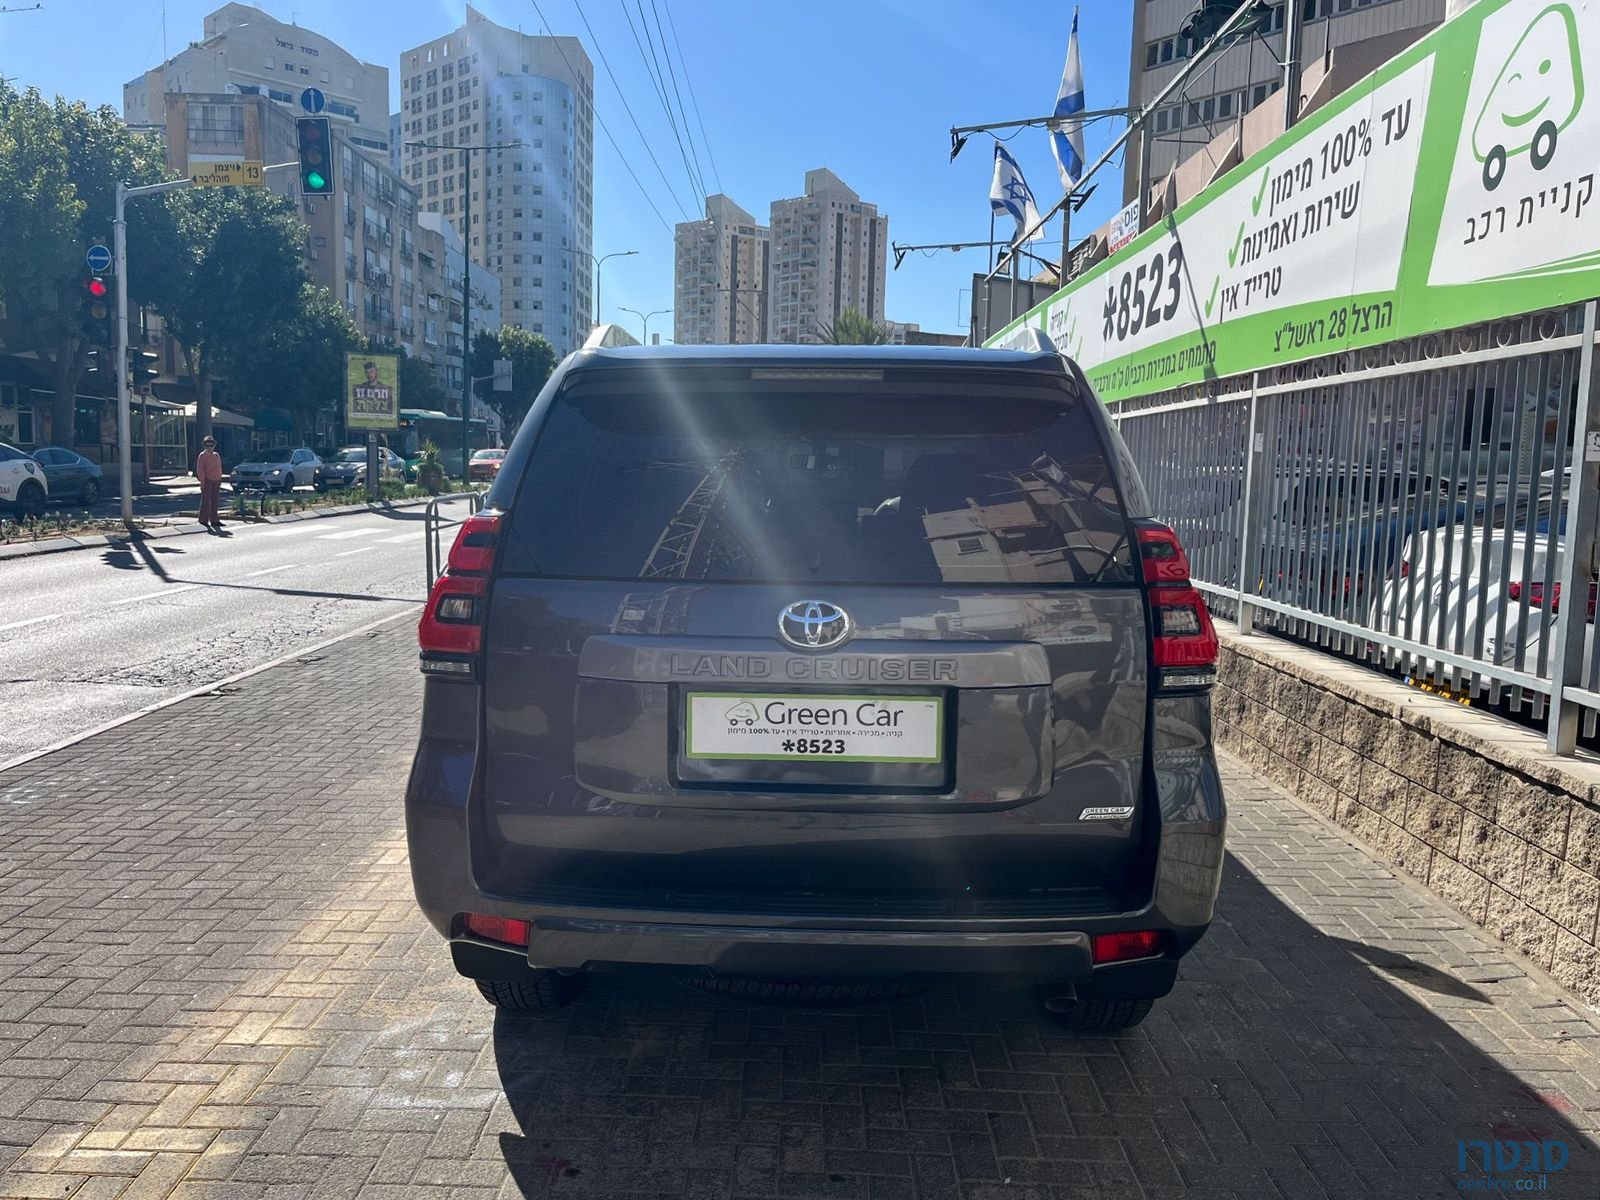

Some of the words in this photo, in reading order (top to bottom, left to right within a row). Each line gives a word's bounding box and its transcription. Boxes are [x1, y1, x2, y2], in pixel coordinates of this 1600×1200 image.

[1381, 98, 1412, 146] עד
[1320, 117, 1372, 180] 100%
[198, 172, 230, 183] מוהליבר
[214, 163, 235, 174] ויצמן
[246, 167, 259, 179] 13
[1269, 157, 1314, 217] מימון
[1516, 173, 1594, 228] קניית
[1301, 181, 1361, 239] שירות
[1464, 206, 1506, 245] רכב
[1240, 212, 1298, 266] ואמינות
[1244, 265, 1283, 306] טרייד
[1219, 283, 1241, 324] אין
[1351, 300, 1393, 336] הרצל
[1328, 307, 1347, 341] 28
[1146, 353, 1176, 380] במכירת
[1178, 340, 1217, 372] מתמחים
[670, 653, 771, 678] LAND
[785, 657, 958, 681] CRUISER
[764, 701, 848, 726] Green
[855, 703, 904, 727] Car
[728, 727, 747, 735] מימון
[786, 728, 798, 736] אין
[800, 728, 819, 736] טרייד
[857, 729, 880, 737] מכירה
[886, 730, 903, 739] קניה
